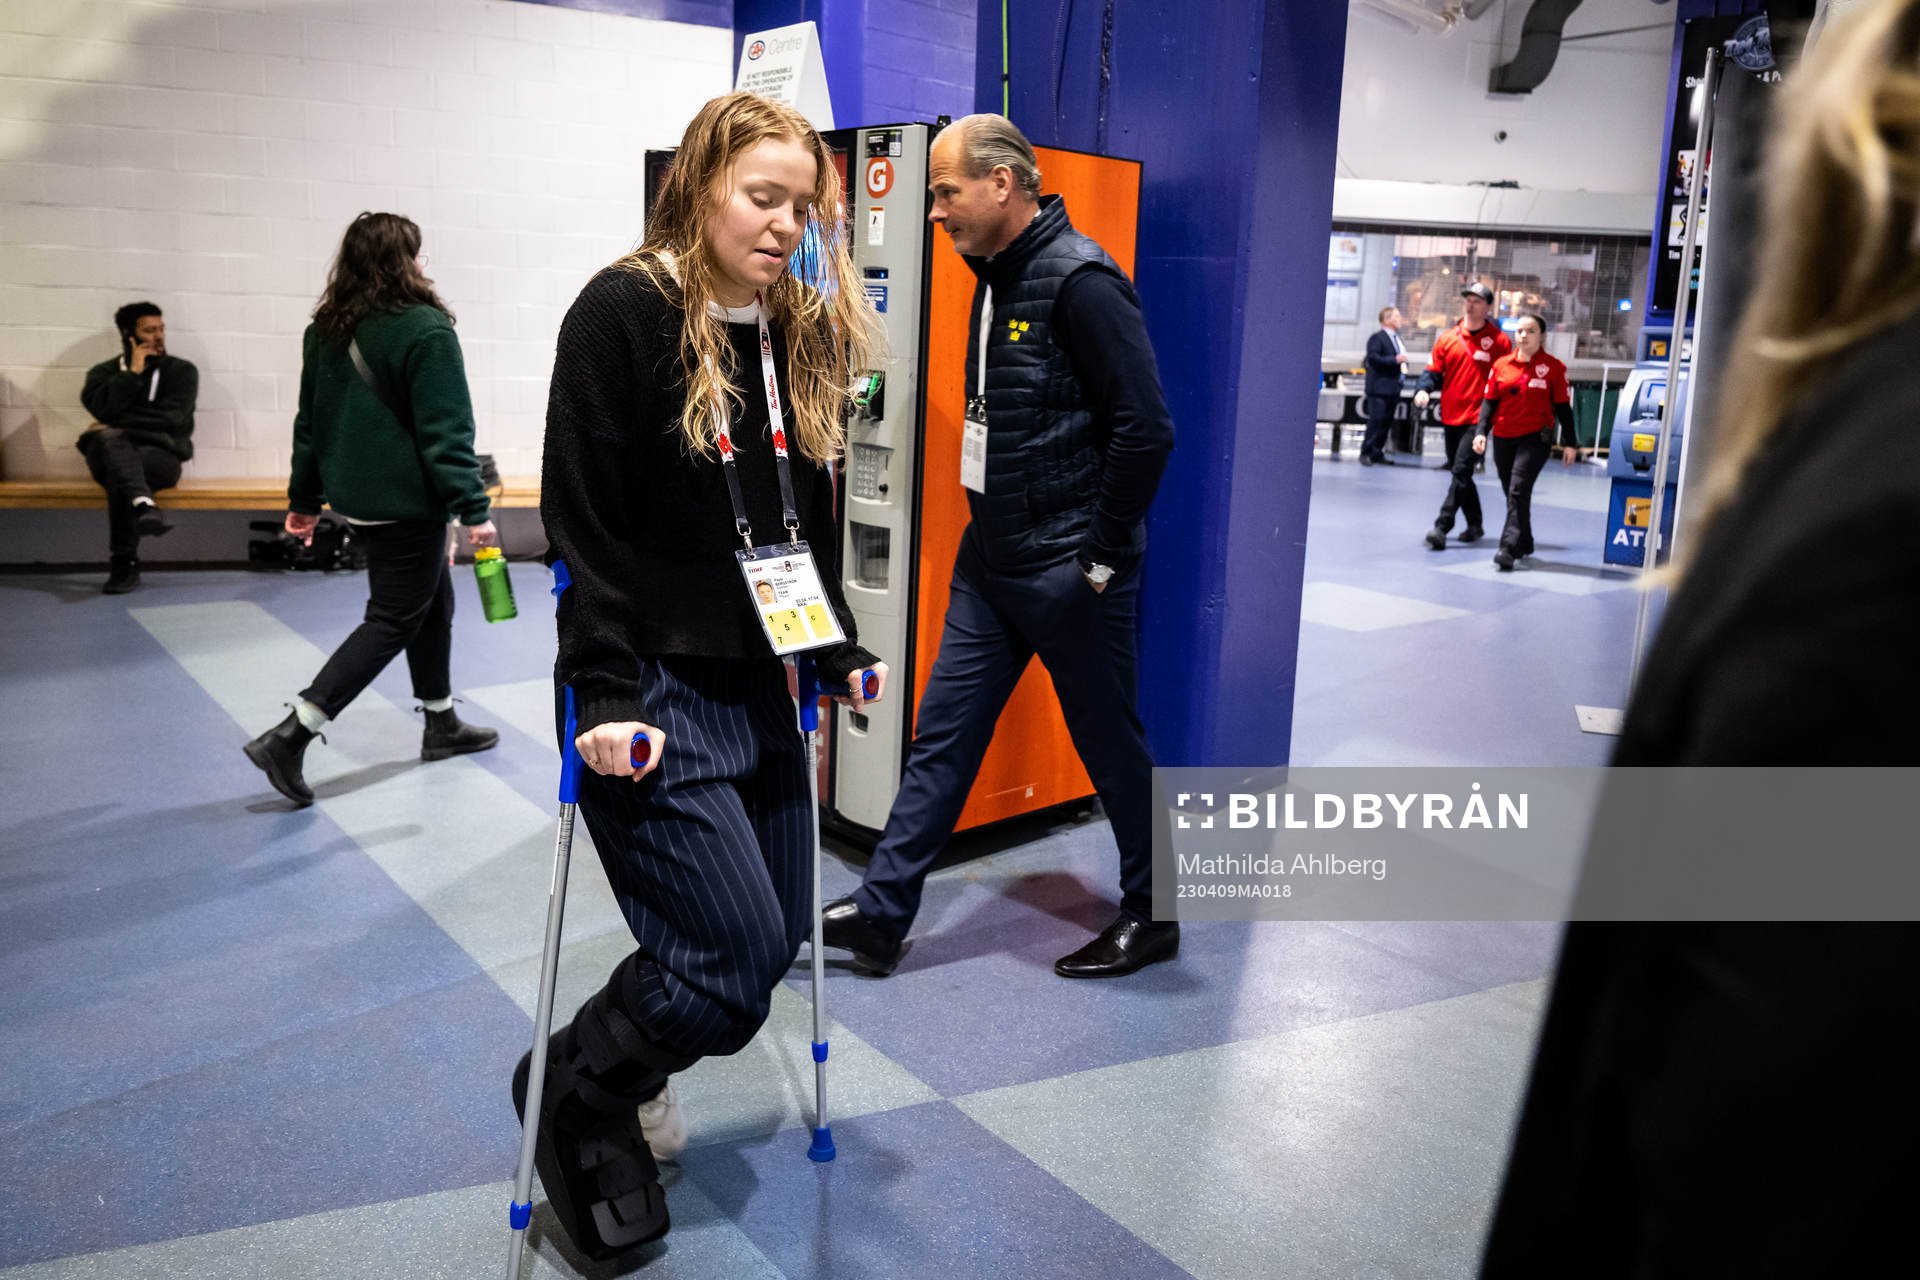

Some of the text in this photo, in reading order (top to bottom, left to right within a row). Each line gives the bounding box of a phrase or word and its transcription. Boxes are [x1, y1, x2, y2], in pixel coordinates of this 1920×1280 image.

[868, 161, 887, 193] G
[769, 615, 775, 623] 1
[790, 610, 797, 618] 3
[784, 623, 790, 631] 5
